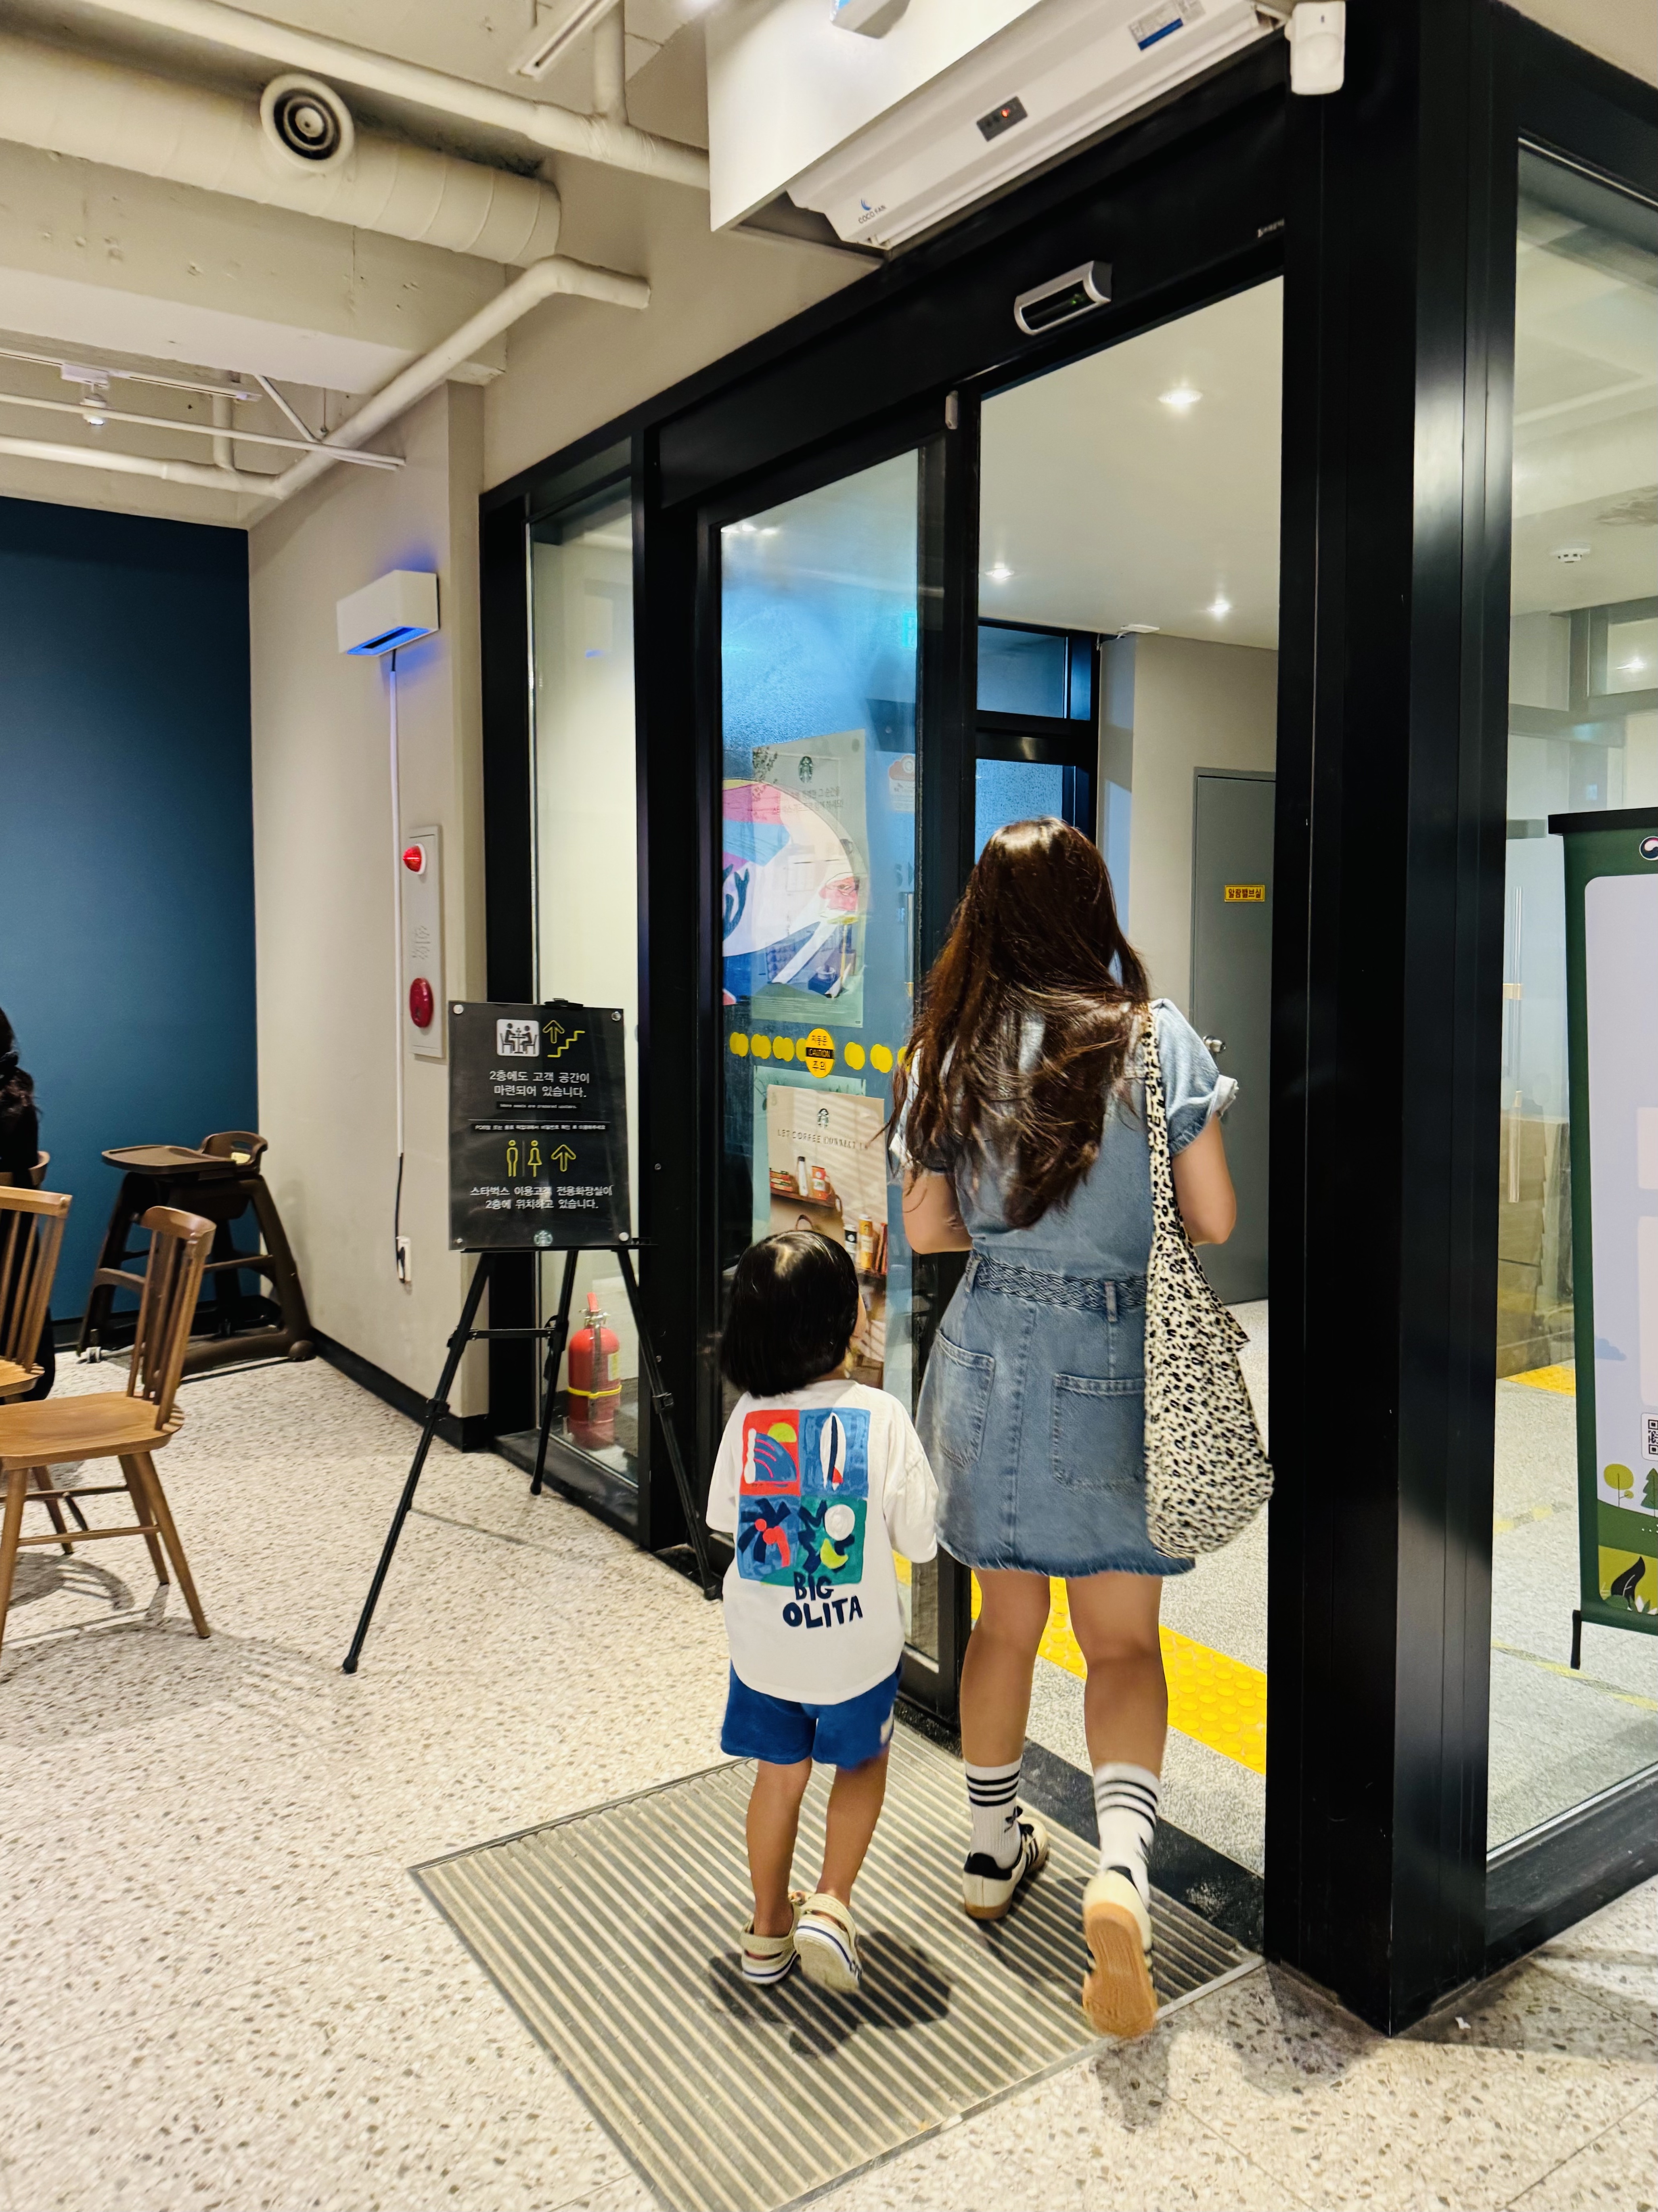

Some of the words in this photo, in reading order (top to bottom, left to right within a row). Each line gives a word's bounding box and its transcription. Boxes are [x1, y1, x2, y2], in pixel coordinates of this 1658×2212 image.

[858, 211, 875, 224] COCO
[1229, 888, 1261, 898] 알람밸브실
[812, 1061, 826, 1071] 주의
[489, 1070, 529, 1082] 2층에도
[532, 1072, 554, 1082] 고객
[559, 1072, 590, 1083] 공간이
[494, 1085, 537, 1097] 마련되어
[542, 1086, 587, 1098] 있습니다.
[792, 1131, 821, 1143] COFFEE
[470, 1186, 510, 1196] 스타벅스
[514, 1186, 553, 1196] 이용고객
[556, 1185, 613, 1196] 전용화장실이
[485, 1199, 511, 1210] 2층에
[515, 1199, 554, 1210] 위치하고
[558, 1199, 599, 1209] 있습니다.
[793, 1571, 834, 1601] BIG
[782, 1595, 863, 1629] OLITA
